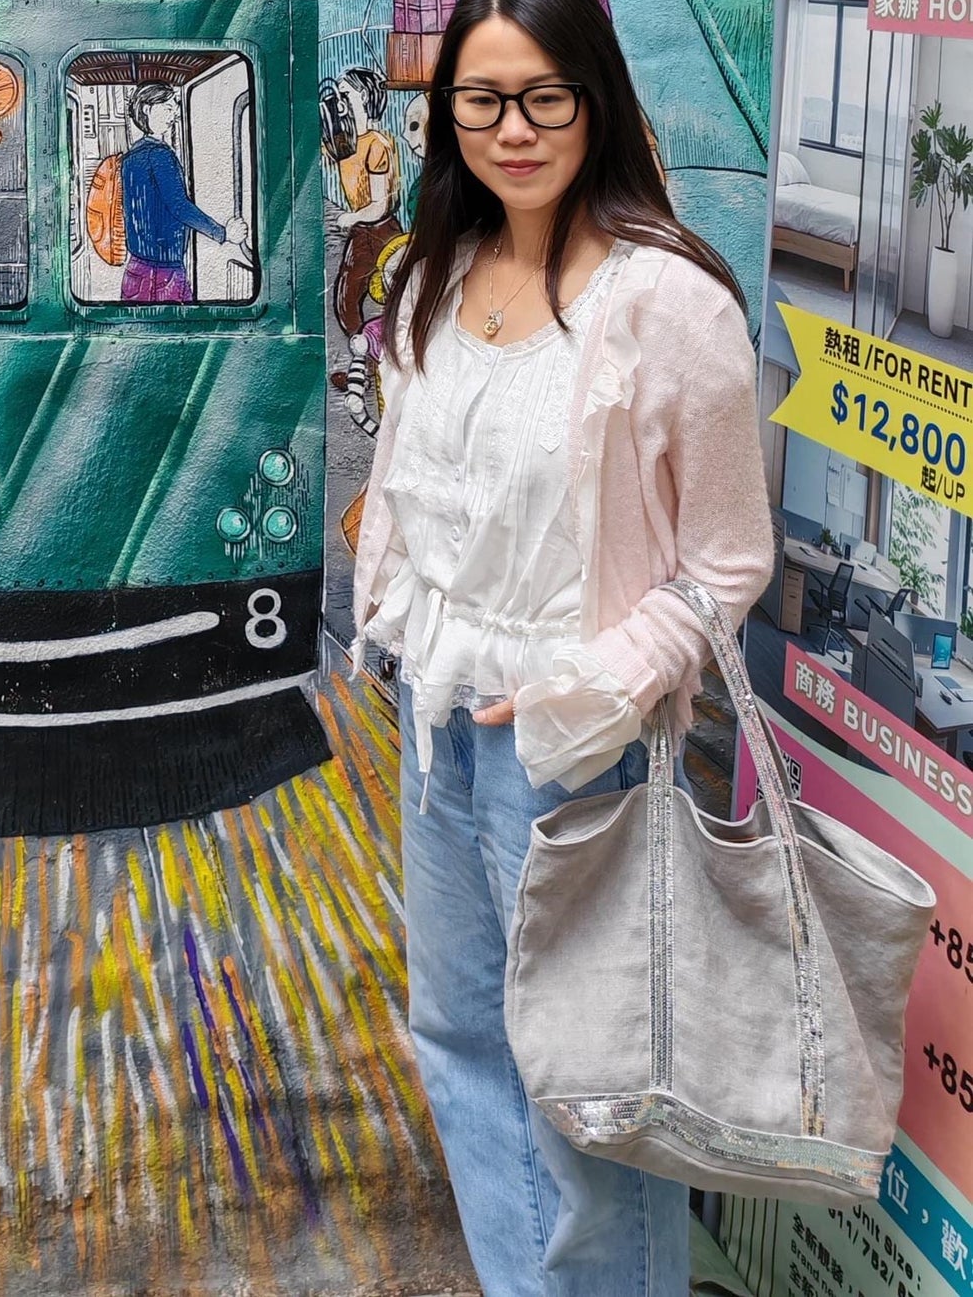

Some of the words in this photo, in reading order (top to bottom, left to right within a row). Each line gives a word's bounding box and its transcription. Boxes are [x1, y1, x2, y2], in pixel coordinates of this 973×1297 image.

[917, 364, 973, 408] RENT
[830, 379, 966, 477] $12,800
[245, 588, 287, 648] 8
[794, 660, 837, 715] 商務
[843, 699, 973, 816] BUSINESS
[923, 1042, 973, 1114] +85
[790, 1238, 820, 1283] Brand
